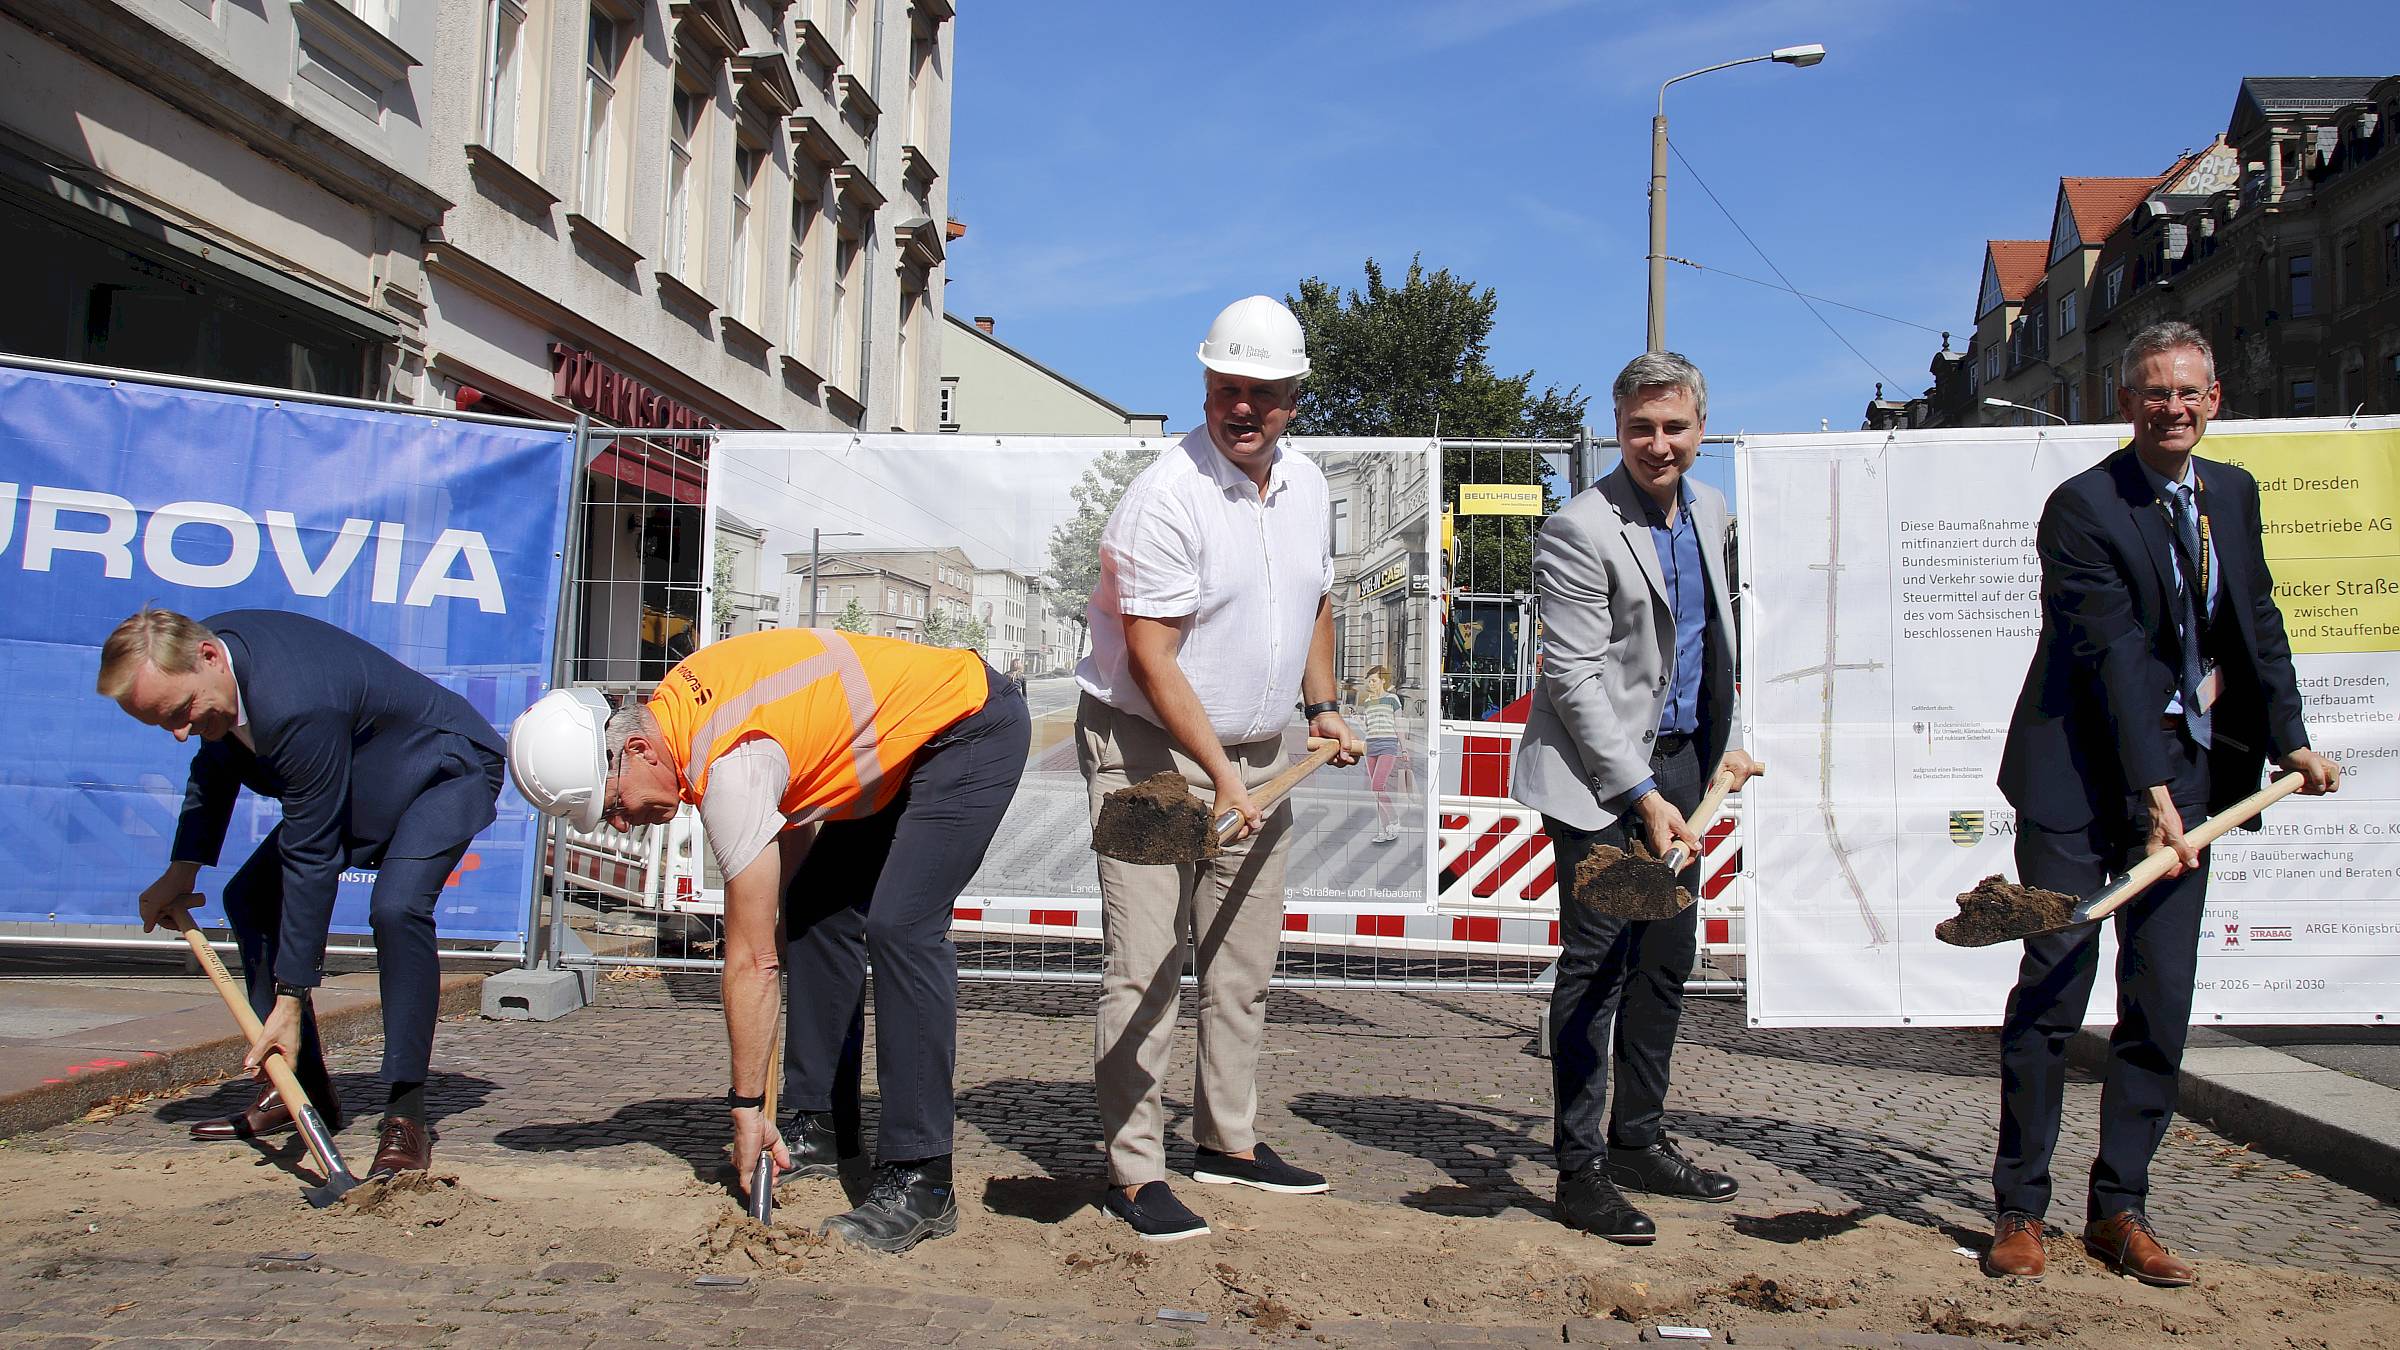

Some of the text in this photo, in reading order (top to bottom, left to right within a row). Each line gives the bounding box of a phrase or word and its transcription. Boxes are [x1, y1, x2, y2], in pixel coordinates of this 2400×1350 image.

[2293, 476, 2359, 491] Dresden
[1464, 492, 1538, 500] BEUTLHAUSER
[1901, 521, 1934, 532] Diese
[1938, 519, 2029, 531] Baumaßnahme
[2368, 518, 2392, 531] AG
[0, 482, 507, 614] ROVIA
[1901, 538, 1979, 549] mitfinanziert
[1982, 536, 2016, 548] durch
[1902, 555, 2019, 567] Bundesministerium
[1902, 574, 1926, 585] und
[1929, 573, 1976, 584] Verkehr
[1980, 573, 2015, 584] sowie
[2336, 578, 2399, 596] Straße
[1903, 591, 1978, 603] Steuermittel
[1982, 590, 2001, 602] auf
[2004, 590, 2025, 601] der
[1903, 610, 1925, 621] des
[1928, 611, 1954, 620] vom
[1957, 608, 2030, 620] Sächsischen
[2294, 605, 2358, 618] zwischen
[1904, 627, 1992, 639] beschlossenen
[2290, 626, 2316, 638] und
[2333, 675, 2390, 688] Dresden,
[2301, 694, 2375, 706] Tiefbauamt
[2303, 712, 2394, 724] kehrsbetriebe
[2346, 747, 2398, 759] Dresden
[2340, 766, 2358, 777] AG
[2304, 824, 2344, 836] GmbH
[2348, 824, 2360, 835] &
[2363, 824, 2384, 835] Co.
[2250, 850, 2354, 862] Bauüberwachung
[338, 872, 377, 884] NSTR
[2216, 868, 2392, 881] VCDB VIC Planen und Beraten
[1070, 884, 1101, 894] Lande
[1302, 887, 1345, 898] Straßen-
[1348, 888, 1366, 898] und
[1368, 888, 1422, 898] Tiefbauamt
[2250, 930, 2292, 938] STRABAG
[2305, 923, 2338, 934] ARGE
[2194, 979, 2217, 990] ber
[2220, 979, 2250, 990] 2026
[2263, 979, 2292, 992] April
[2296, 979, 2325, 990] 2030
